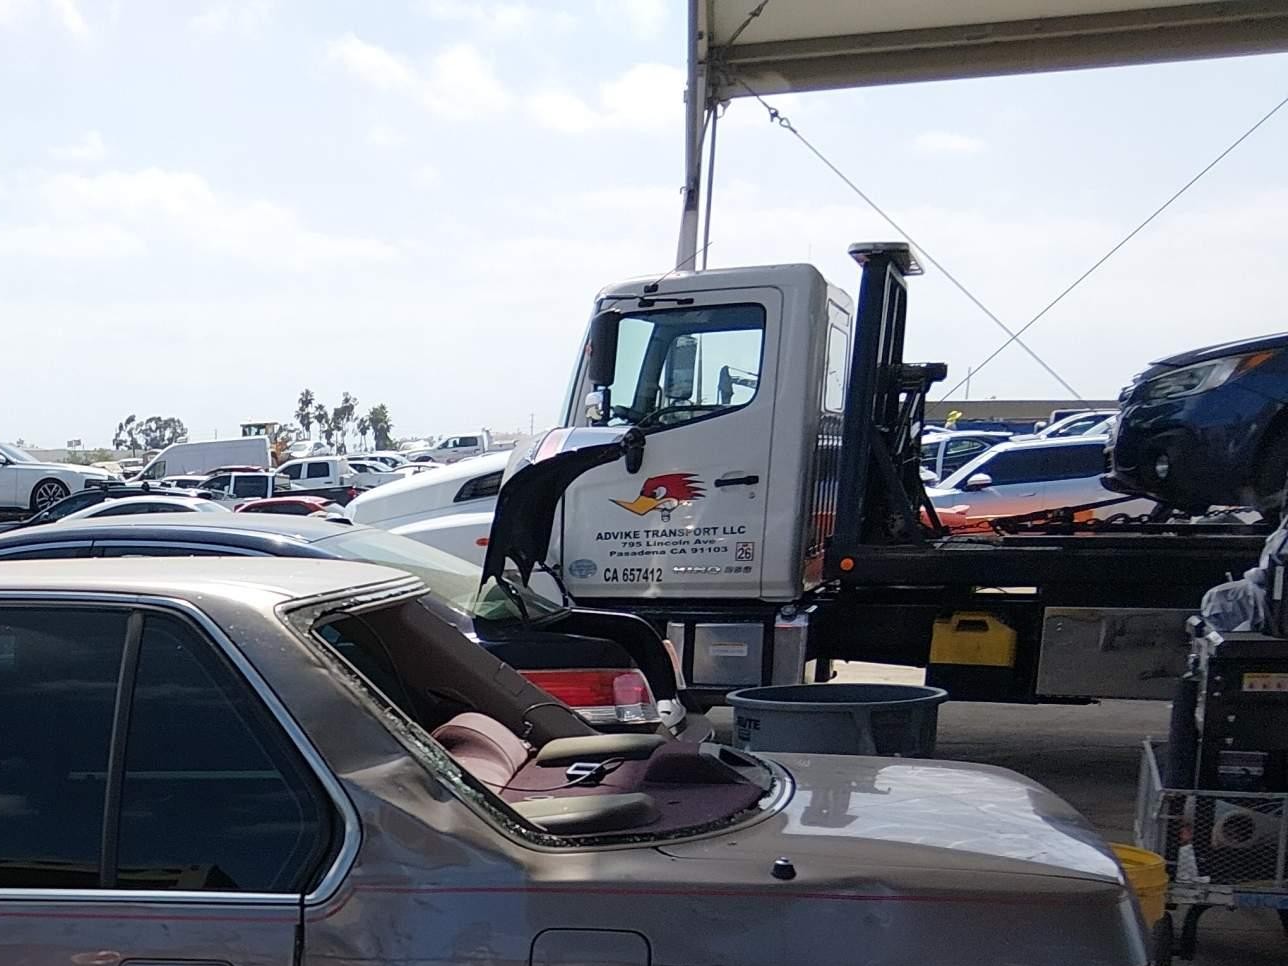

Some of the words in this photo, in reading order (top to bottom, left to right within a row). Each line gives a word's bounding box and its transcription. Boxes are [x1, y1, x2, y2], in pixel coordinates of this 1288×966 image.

[596, 530, 640, 541] ADVIKE
[644, 527, 719, 538] TRANSPORT
[723, 525, 746, 535] LLC
[646, 539, 690, 547] Lincoln
[691, 546, 728, 554] 91103
[737, 547, 751, 559] 26
[604, 567, 619, 582] CA
[622, 567, 663, 582] 657412
